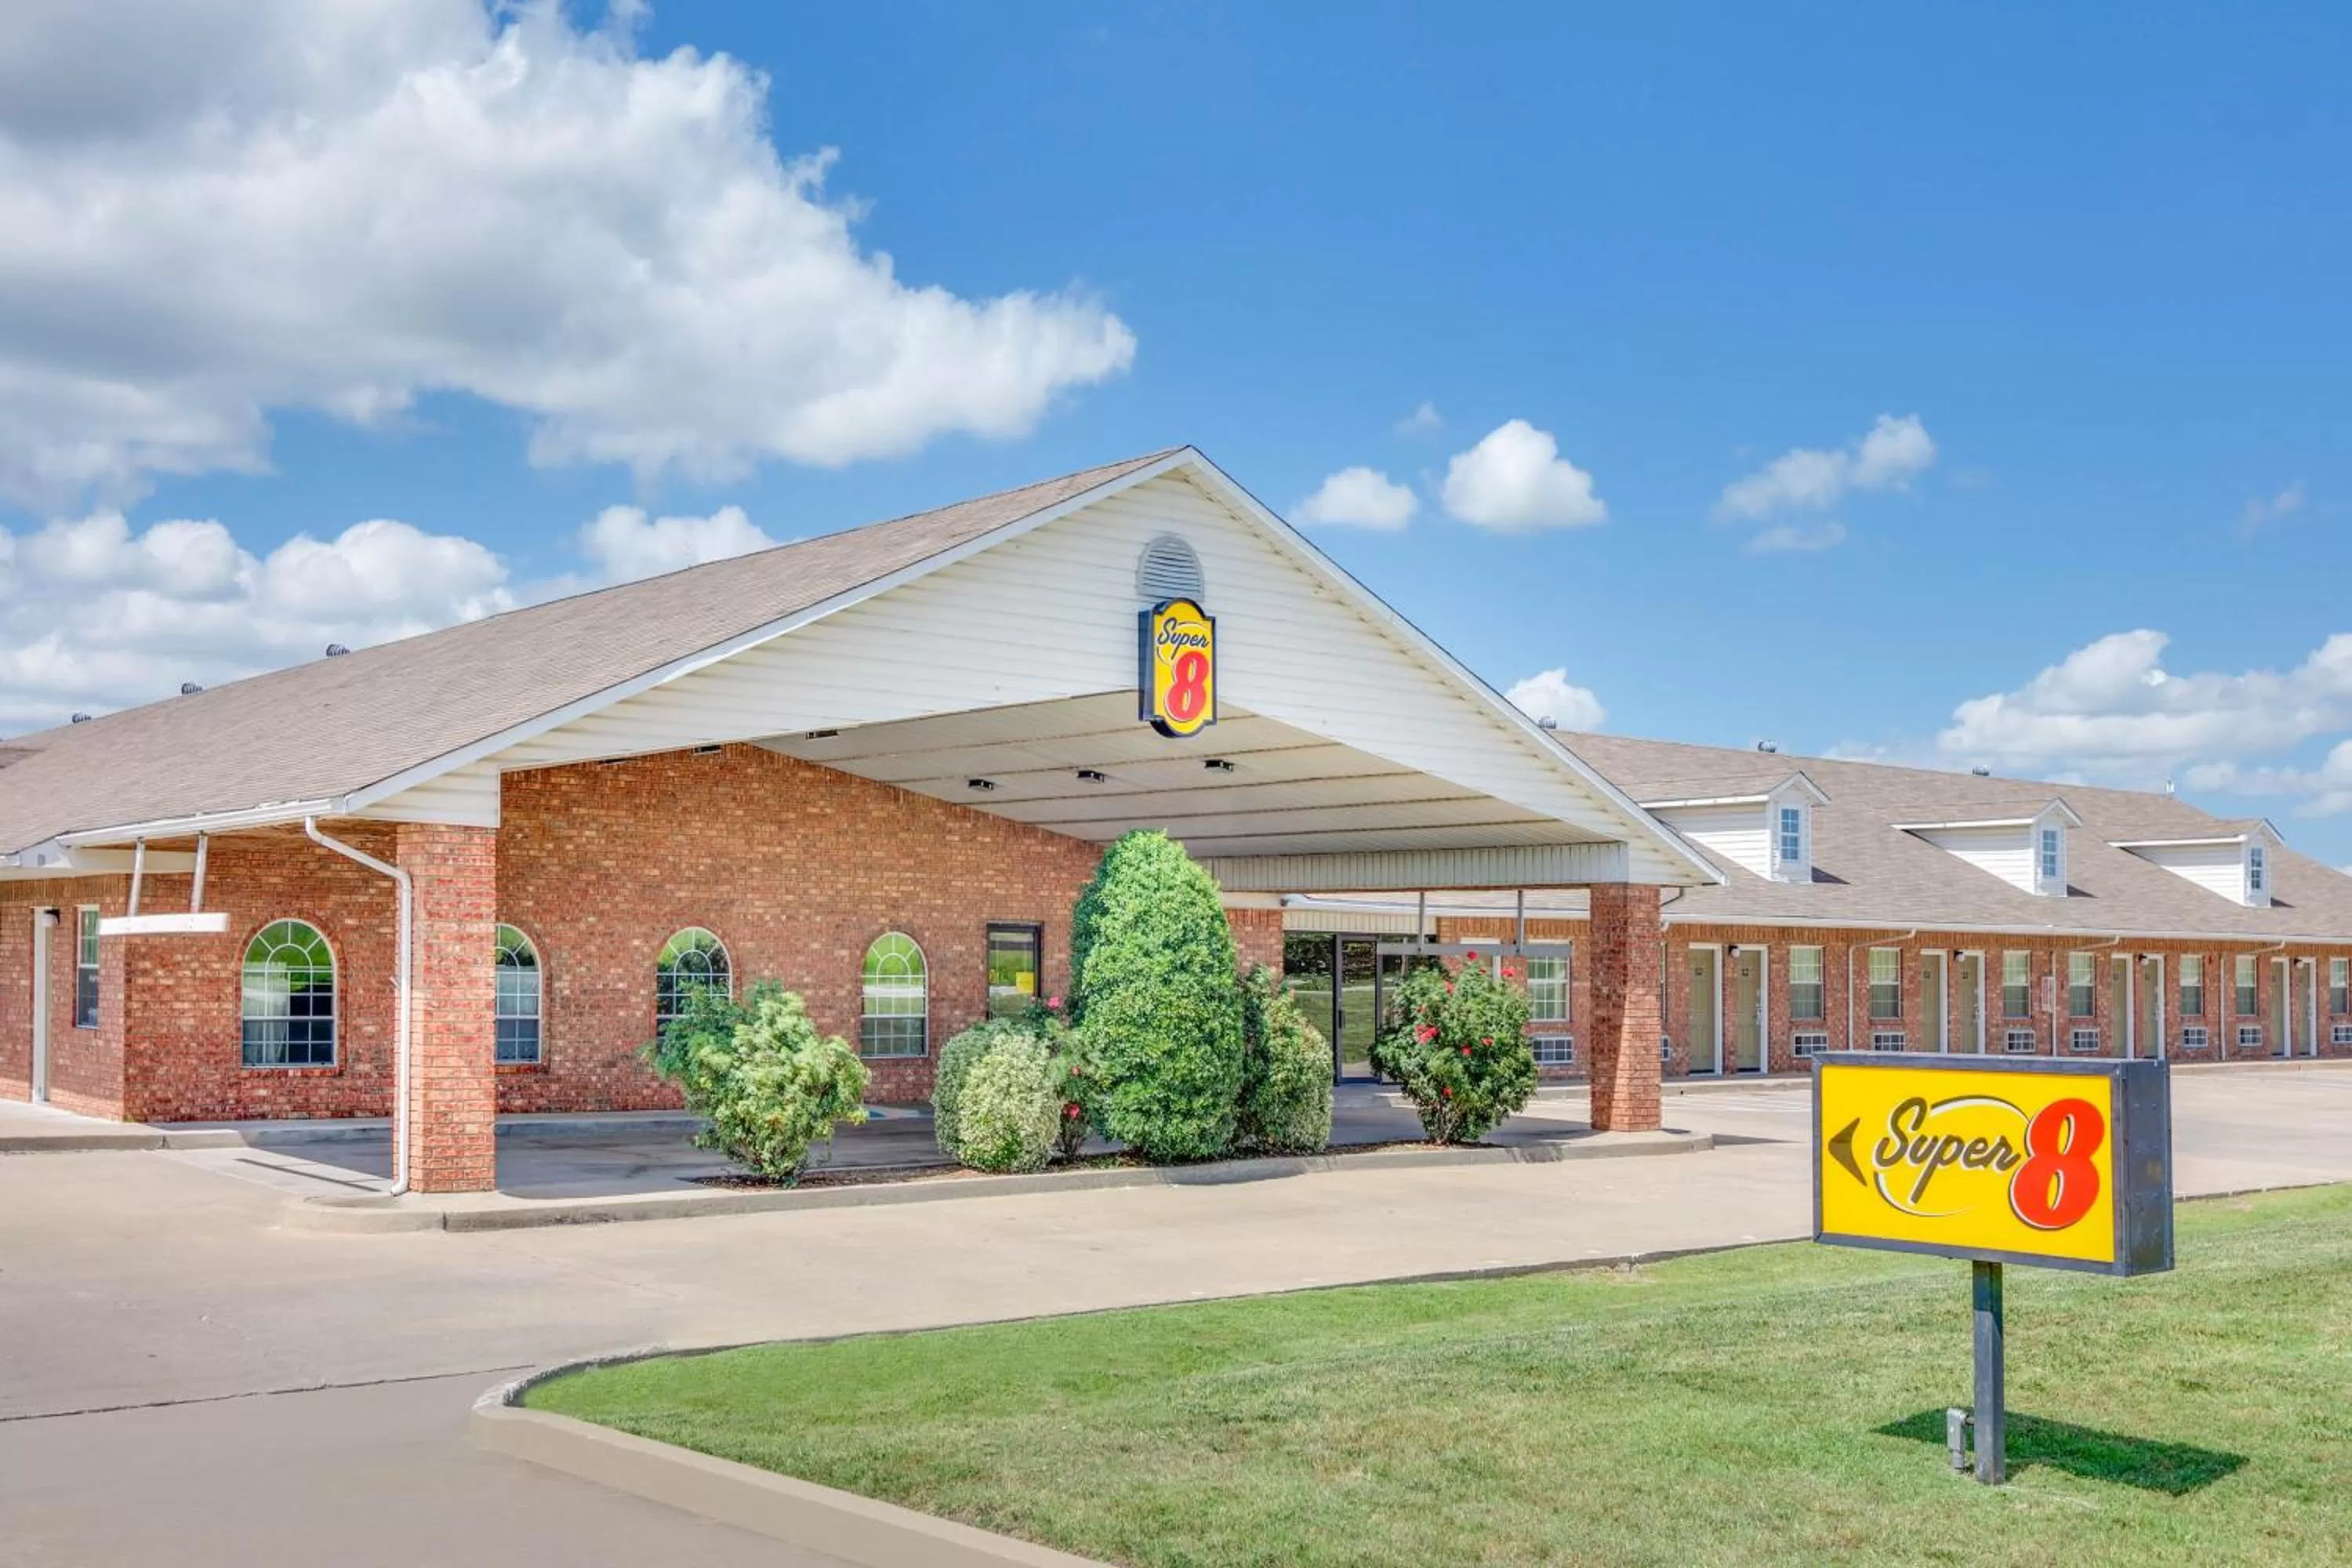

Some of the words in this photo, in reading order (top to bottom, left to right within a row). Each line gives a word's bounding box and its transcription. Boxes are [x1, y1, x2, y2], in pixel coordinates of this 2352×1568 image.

[1156, 618, 1210, 660] Super
[1164, 652, 1209, 722] 8
[1873, 1097, 2022, 1207] Super
[2009, 1098, 2104, 1230] 8
